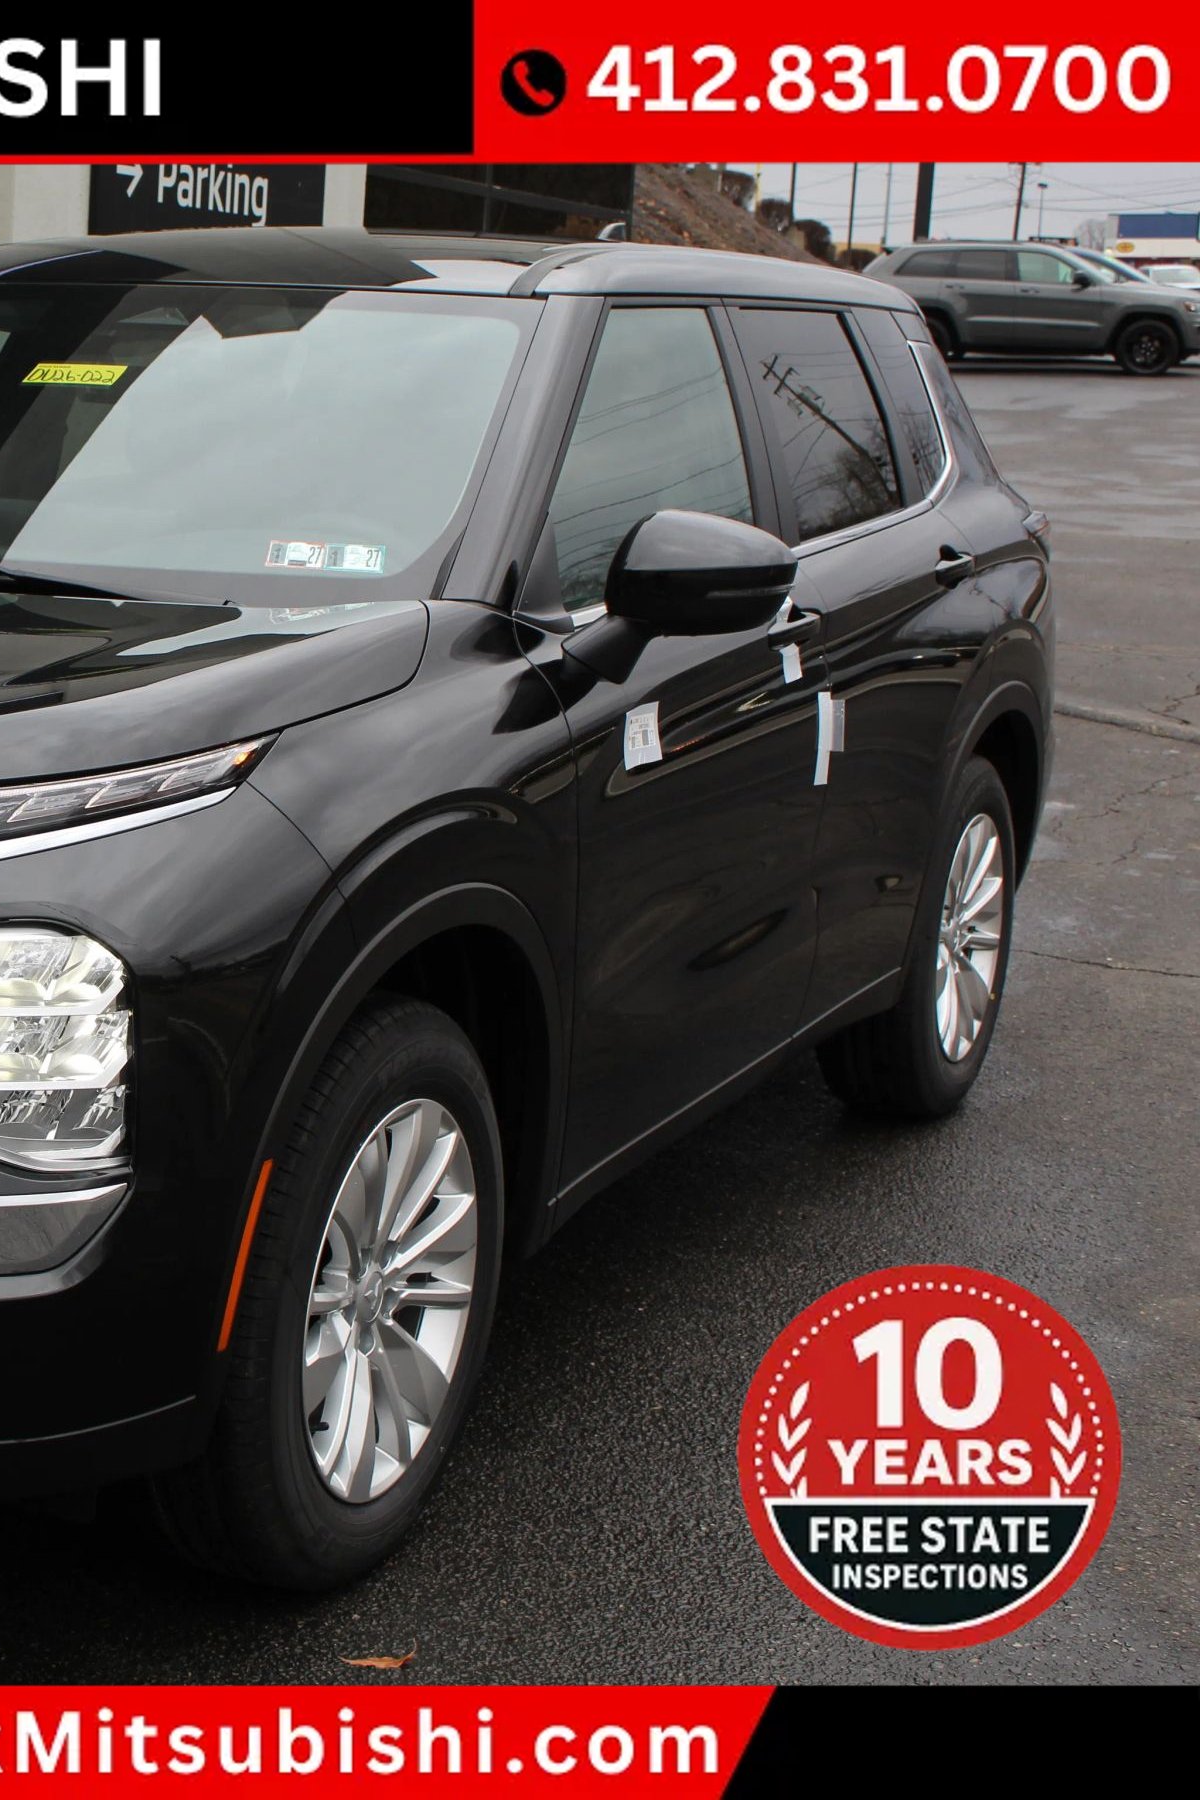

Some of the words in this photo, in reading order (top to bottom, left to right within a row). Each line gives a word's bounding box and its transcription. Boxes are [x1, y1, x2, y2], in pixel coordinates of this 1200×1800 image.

[157, 164, 269, 227] Parking
[308, 546, 321, 565] 27
[366, 549, 380, 568] 27
